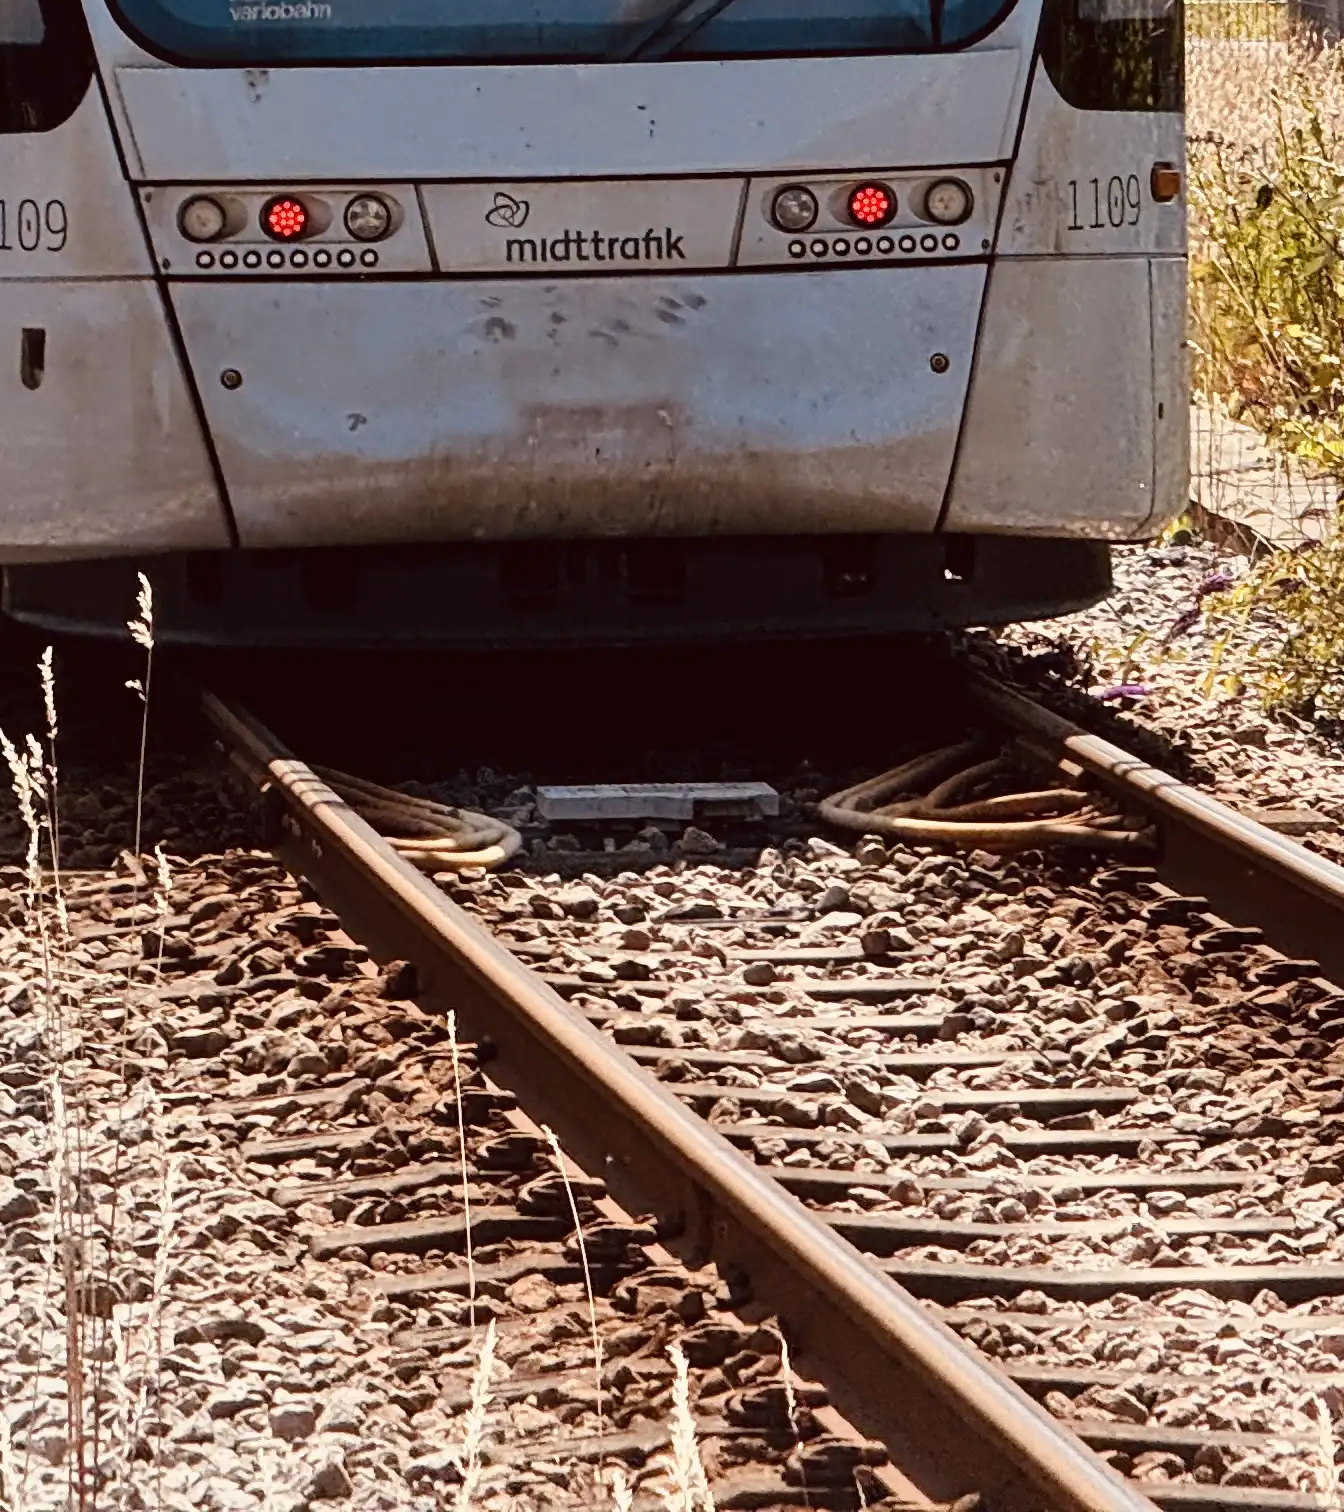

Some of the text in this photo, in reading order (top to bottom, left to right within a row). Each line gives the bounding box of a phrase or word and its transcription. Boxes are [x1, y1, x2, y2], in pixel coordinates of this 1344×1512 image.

[228, 0, 332, 21] variobahn
[1067, 173, 1141, 231] 1109
[505, 227, 686, 262] midttrafik
